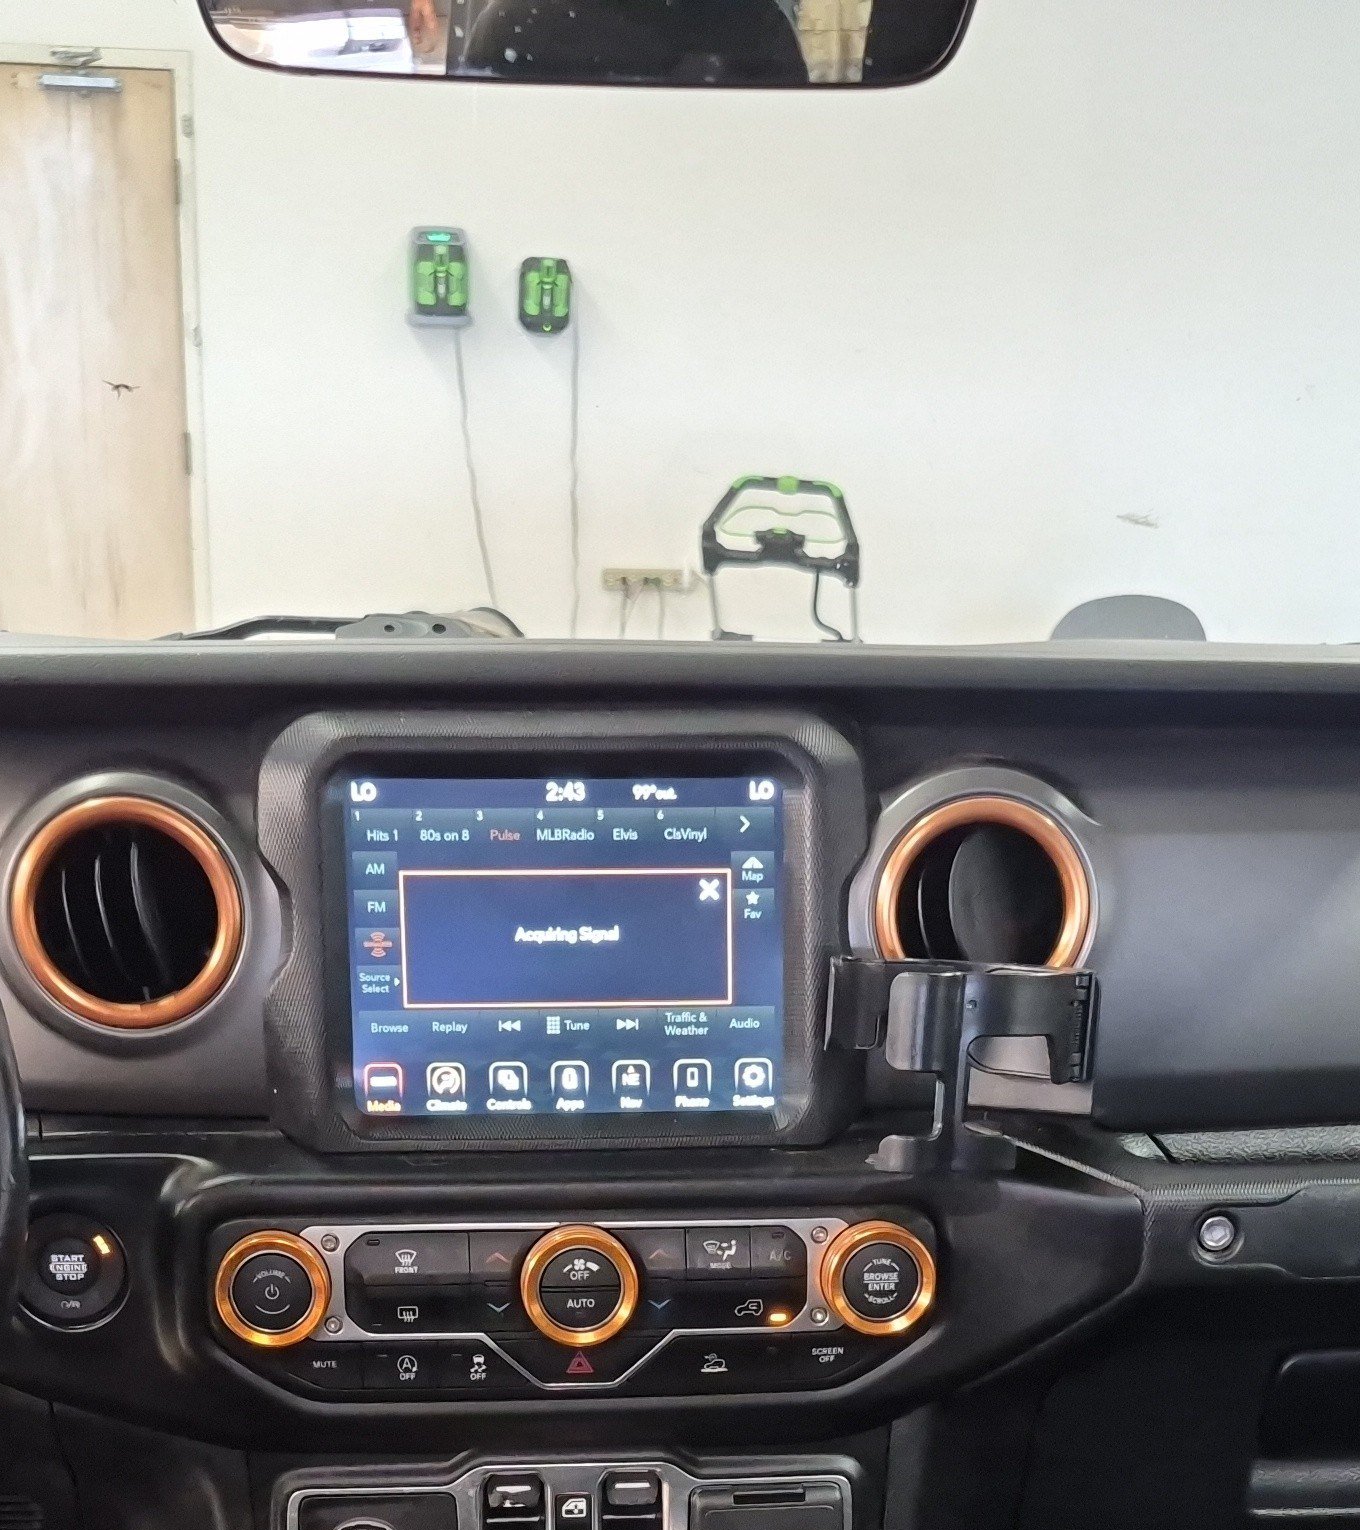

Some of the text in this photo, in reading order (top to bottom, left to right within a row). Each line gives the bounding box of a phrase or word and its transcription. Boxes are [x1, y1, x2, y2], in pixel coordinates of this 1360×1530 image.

[351, 781, 378, 801] LO
[546, 781, 586, 802] 2:43
[749, 781, 775, 800] LO
[355, 811, 360, 821] 1
[415, 811, 423, 821] 2
[476, 810, 484, 821] 3
[537, 810, 544, 821] 4
[597, 810, 604, 820] 5
[657, 810, 664, 820] 6
[366, 829, 390, 841] Hits
[420, 829, 470, 841] 80s on 8
[490, 829, 521, 842] Pulse
[536, 828, 595, 842] MLBRadio
[613, 828, 638, 841] Elvis
[664, 828, 708, 843] ClsVinyl
[365, 863, 385, 875] AM
[742, 871, 764, 883] Map
[367, 901, 386, 913] FM
[744, 909, 761, 919] Fav
[514, 925, 620, 944] Acquiring Signal
[359, 973, 390, 982] Source
[362, 984, 390, 994] Select
[665, 1012, 708, 1023] Traffic &
[371, 1022, 409, 1033] Browse
[432, 1021, 468, 1034] Replay
[564, 1019, 590, 1031] Tune
[730, 1018, 760, 1029] Audio
[664, 1024, 709, 1036] Weather
[367, 1100, 402, 1112] Media
[556, 1097, 585, 1111] Apps
[50, 1254, 85, 1262] START
[769, 1250, 791, 1261] A/C
[872, 1258, 891, 1266] TUNE
[49, 1263, 88, 1273] ENGINE
[395, 1265, 418, 1273] FRONT
[56, 1273, 85, 1281] STOP
[570, 1271, 590, 1280] OFF
[863, 1272, 899, 1281] BROWSE
[868, 1282, 896, 1291] ENTER
[566, 1298, 595, 1308] AUTO
[867, 1295, 894, 1304] SCROLL
[819, 1355, 835, 1363] OFF
